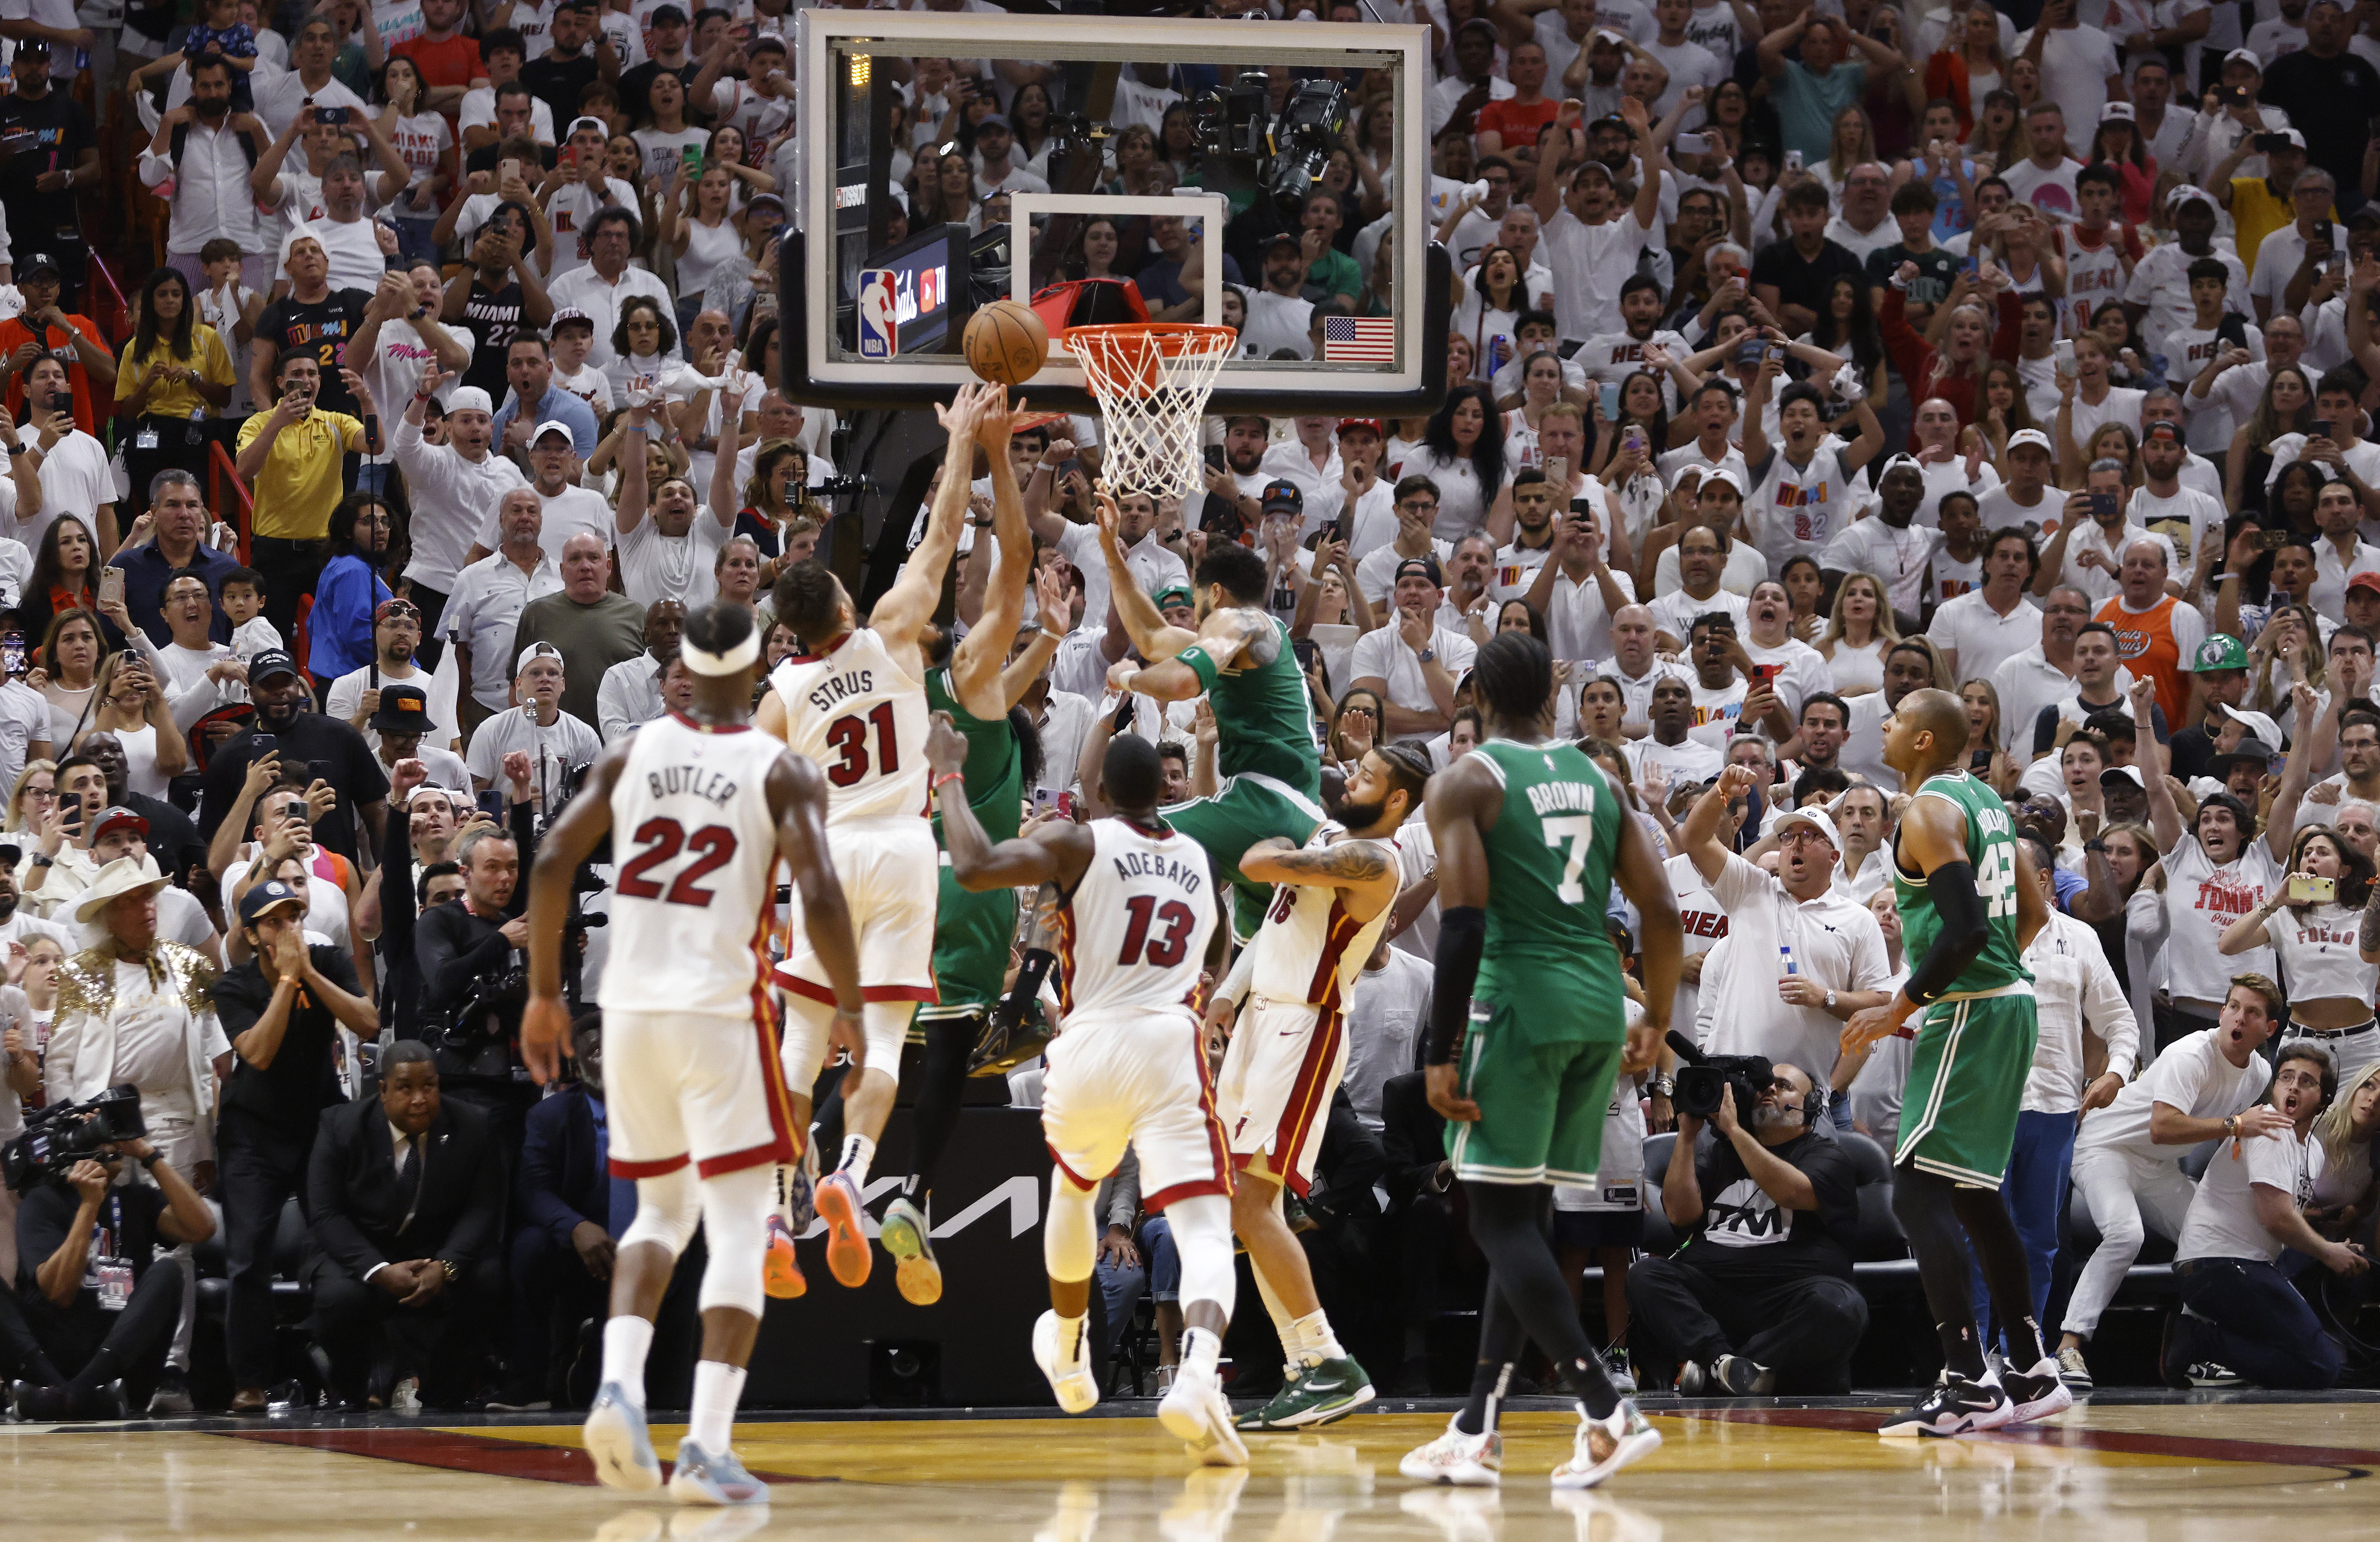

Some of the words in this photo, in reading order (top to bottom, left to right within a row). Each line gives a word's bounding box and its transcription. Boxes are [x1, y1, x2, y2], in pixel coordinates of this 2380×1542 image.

[840, 184, 867, 208] TISSOT
[933, 265, 945, 304] TV
[464, 302, 520, 322] MIAMI
[287, 319, 347, 346] MIAMI
[864, 338, 884, 353] NBA
[386, 343, 431, 361] Miam
[810, 671, 872, 712] STRUS
[826, 700, 899, 788] 31
[573, 761, 593, 773] CULT
[648, 765, 737, 812] BUTLER
[1526, 782, 1595, 815] BROWN
[616, 816, 738, 908] 22
[1113, 852, 1200, 894] ADEBAYO
[1541, 815, 1593, 905] 7
[1977, 840, 2017, 918] 42
[1267, 887, 1297, 924] 16
[1117, 895, 1196, 968] 13
[1681, 910, 1729, 939] HEA
[2297, 928, 2355, 945] FUEGO
